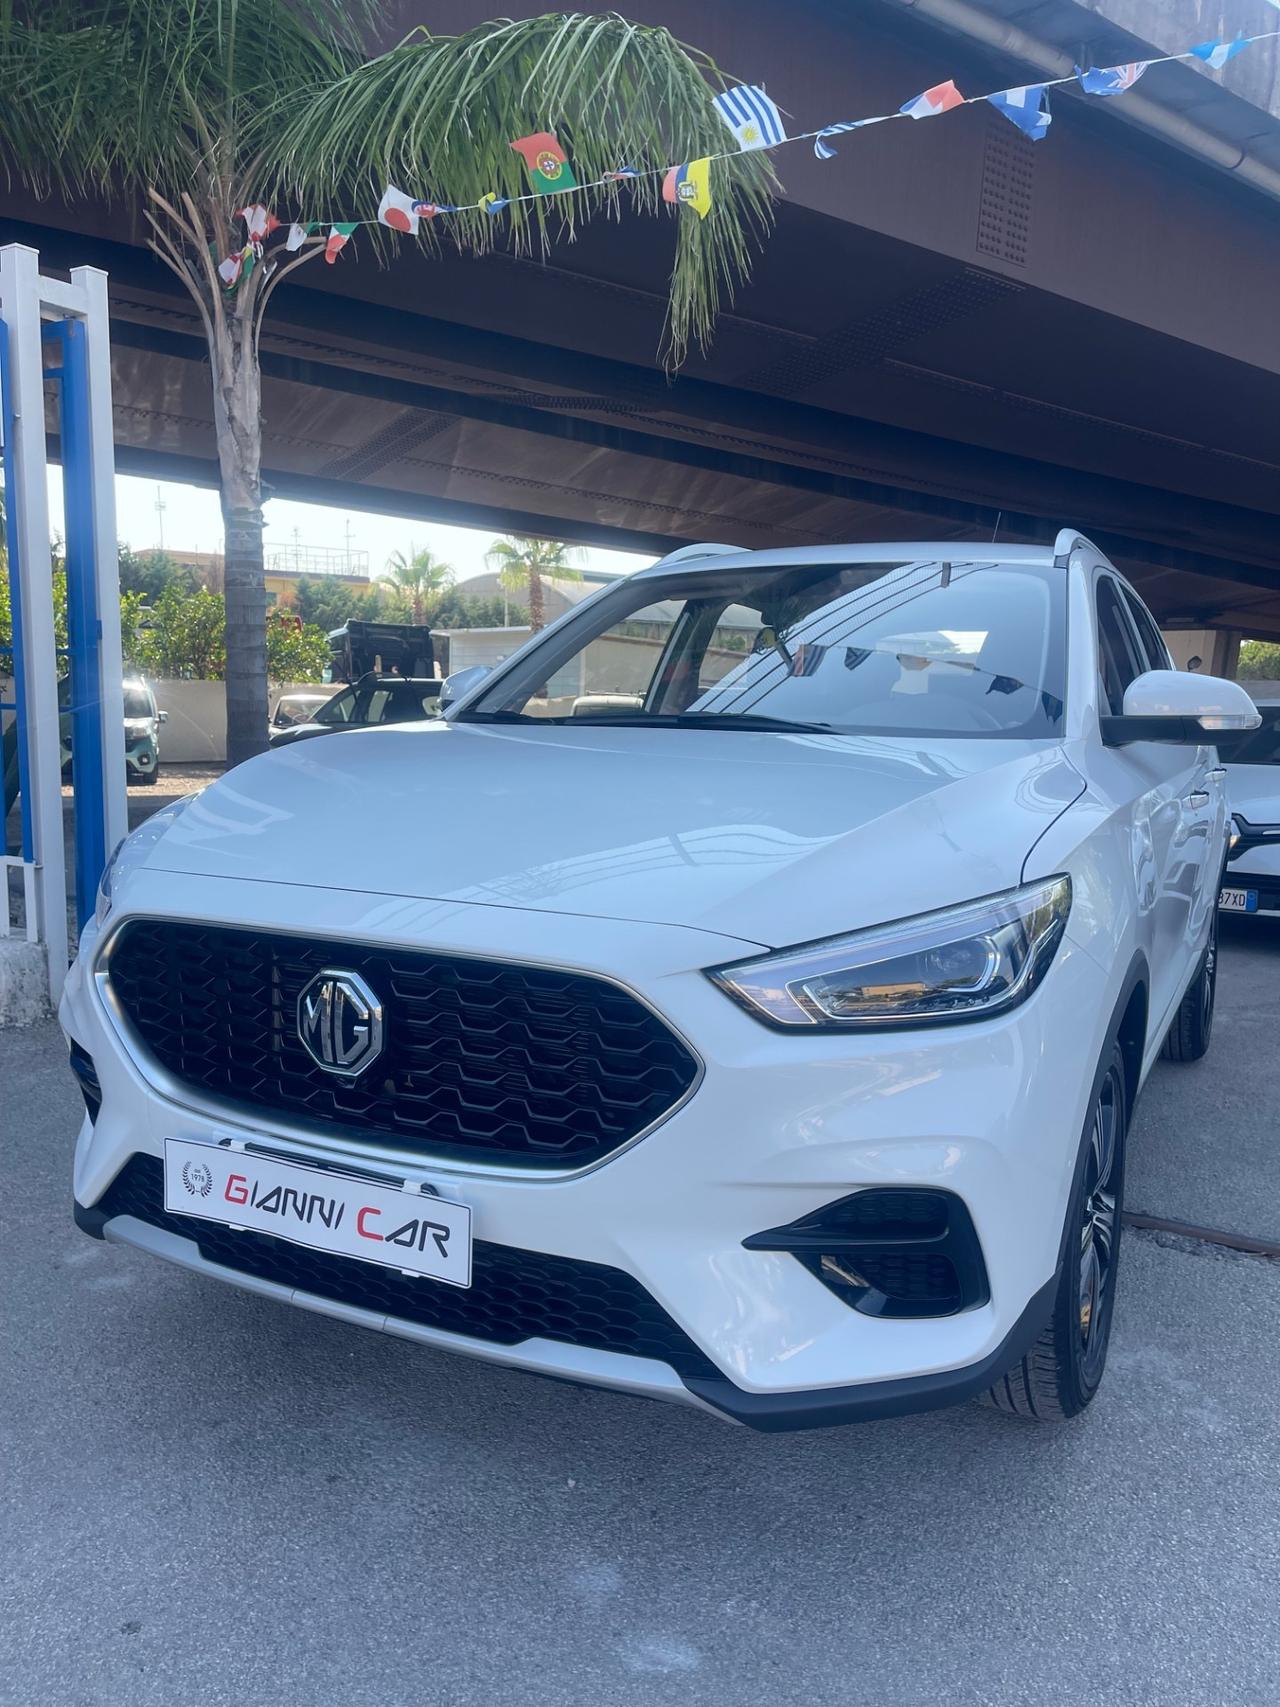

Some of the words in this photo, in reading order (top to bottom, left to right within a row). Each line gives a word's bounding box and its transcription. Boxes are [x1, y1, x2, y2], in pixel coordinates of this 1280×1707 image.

[303, 981, 369, 1065] MG
[225, 1174, 345, 1229] GIANNI
[357, 1207, 450, 1258] CAR
